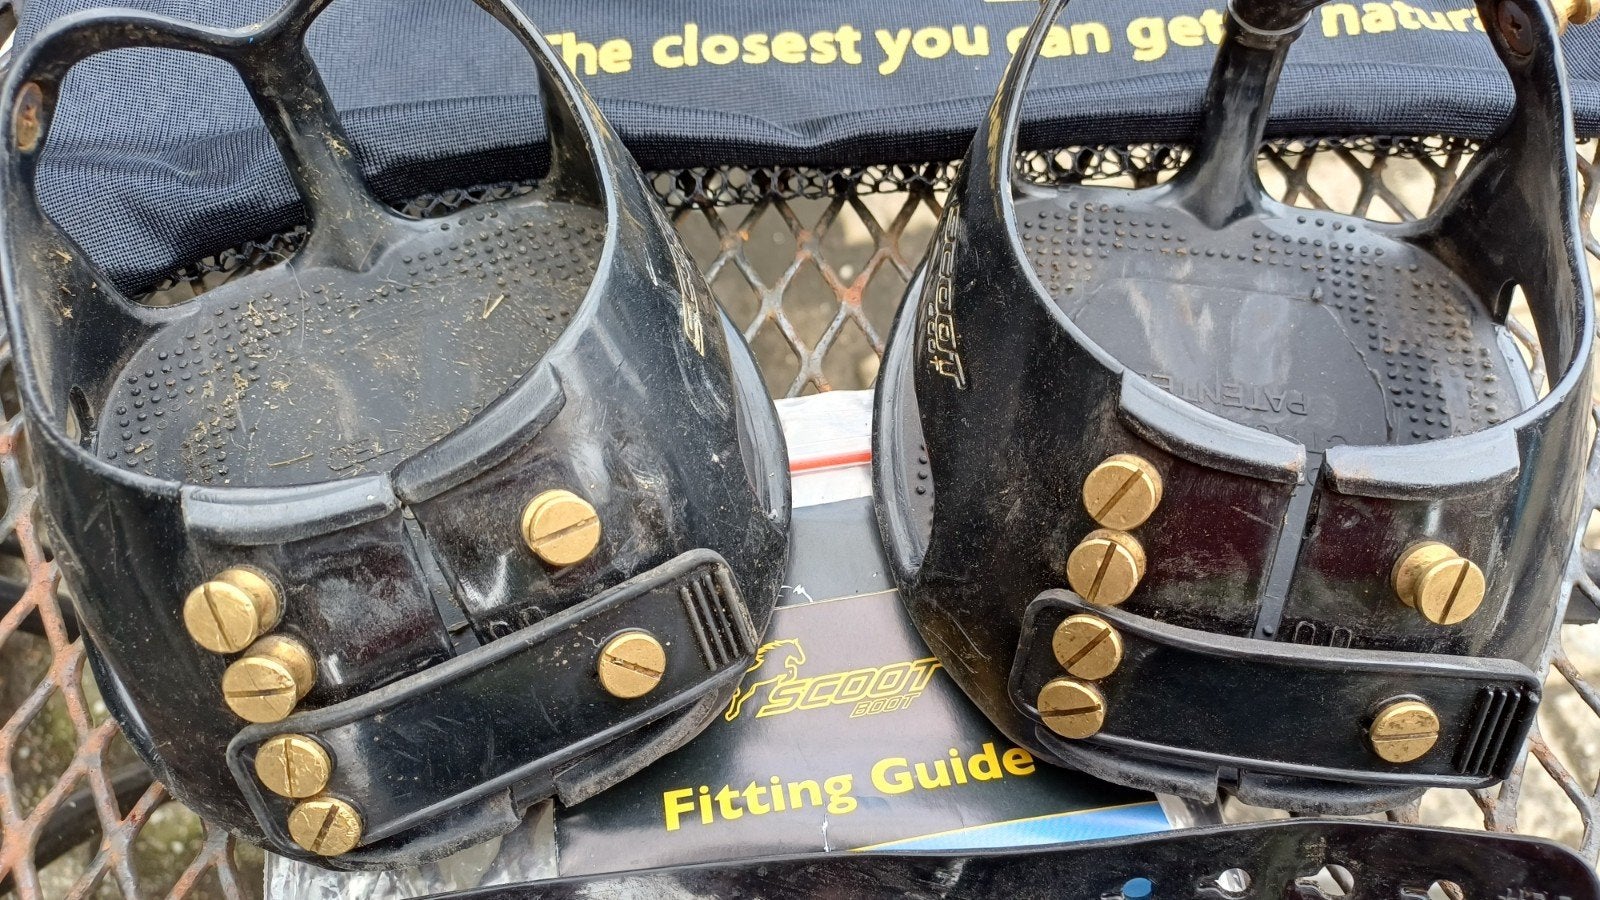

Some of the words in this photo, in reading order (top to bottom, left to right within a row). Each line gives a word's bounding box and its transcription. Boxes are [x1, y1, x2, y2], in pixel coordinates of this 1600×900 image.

[652, 23, 863, 67] closest
[876, 24, 990, 76] you
[1005, 22, 1112, 59] can
[1126, 8, 1224, 62] get
[1142, 373, 1309, 416] PATENTE
[755, 656, 942, 719] SCOOT
[848, 691, 923, 719] BOOT
[662, 772, 859, 832] Fitting
[870, 741, 1036, 795] Guide
